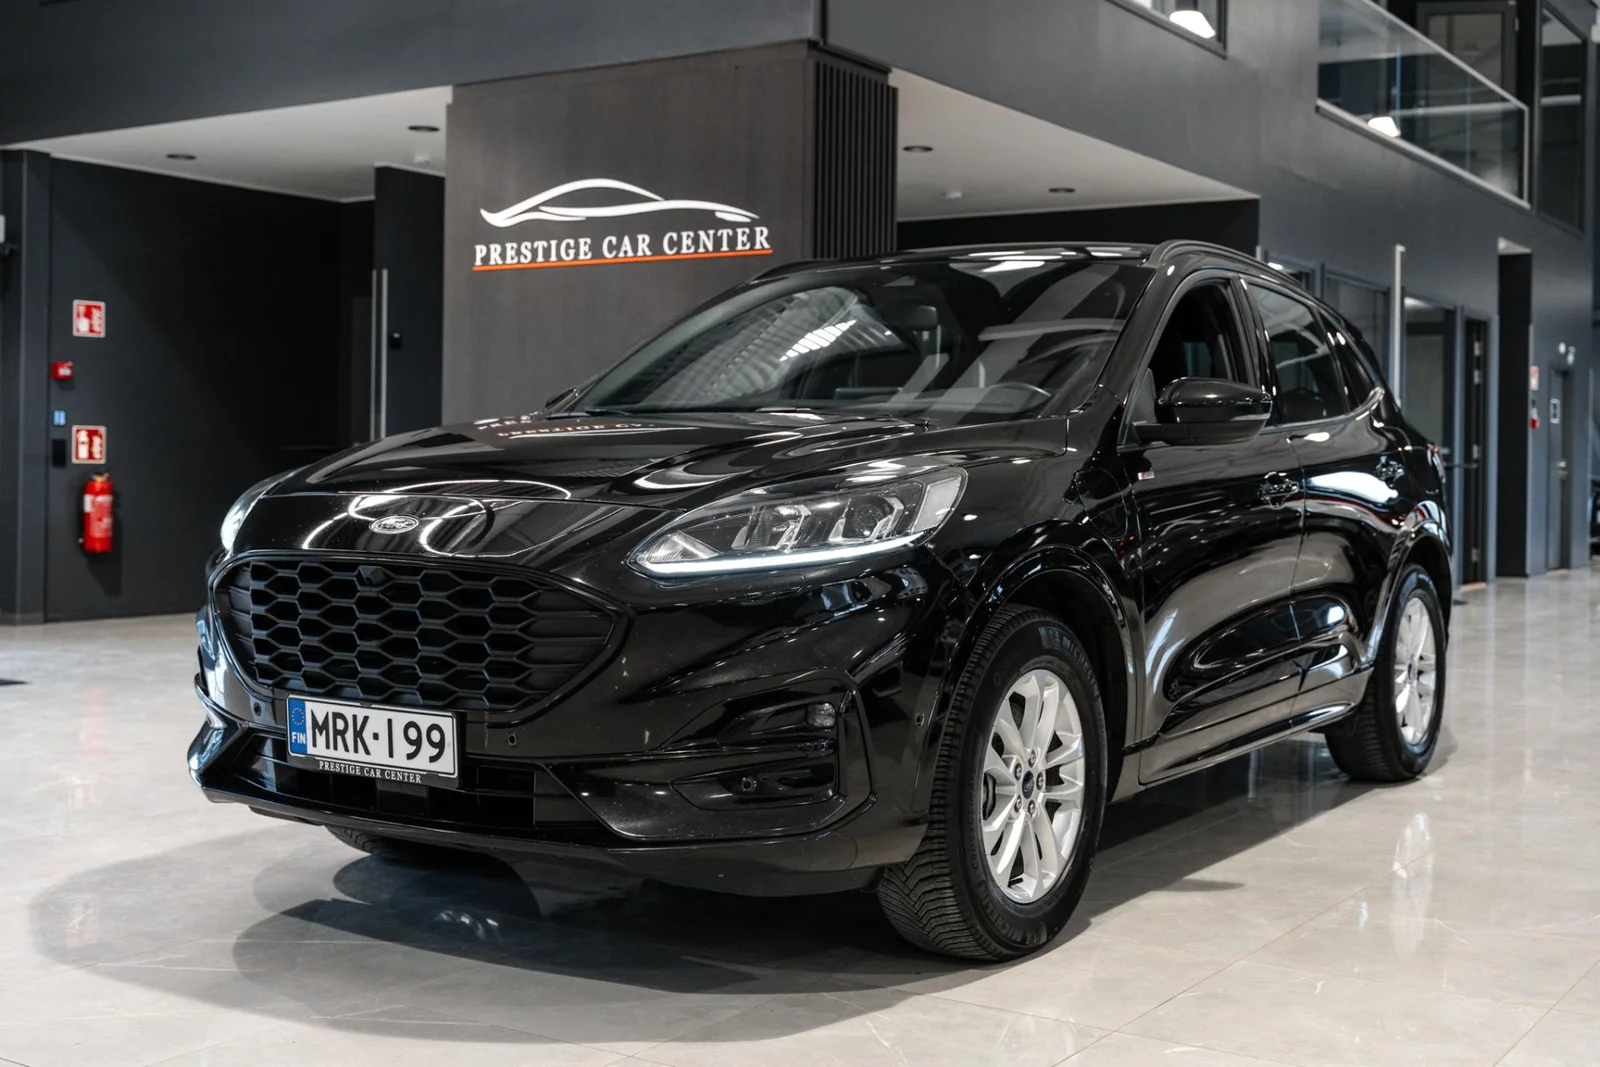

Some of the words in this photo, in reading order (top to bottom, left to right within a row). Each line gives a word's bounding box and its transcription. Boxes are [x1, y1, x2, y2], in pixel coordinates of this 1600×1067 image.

[474, 238, 592, 266] PRESTIGE
[602, 234, 652, 259] CAR
[662, 227, 772, 255] CENTER
[292, 732, 306, 745] FIN
[319, 760, 361, 776] PRESTIGE
[363, 767, 382, 778] CAR
[385, 770, 422, 784] CENTER
